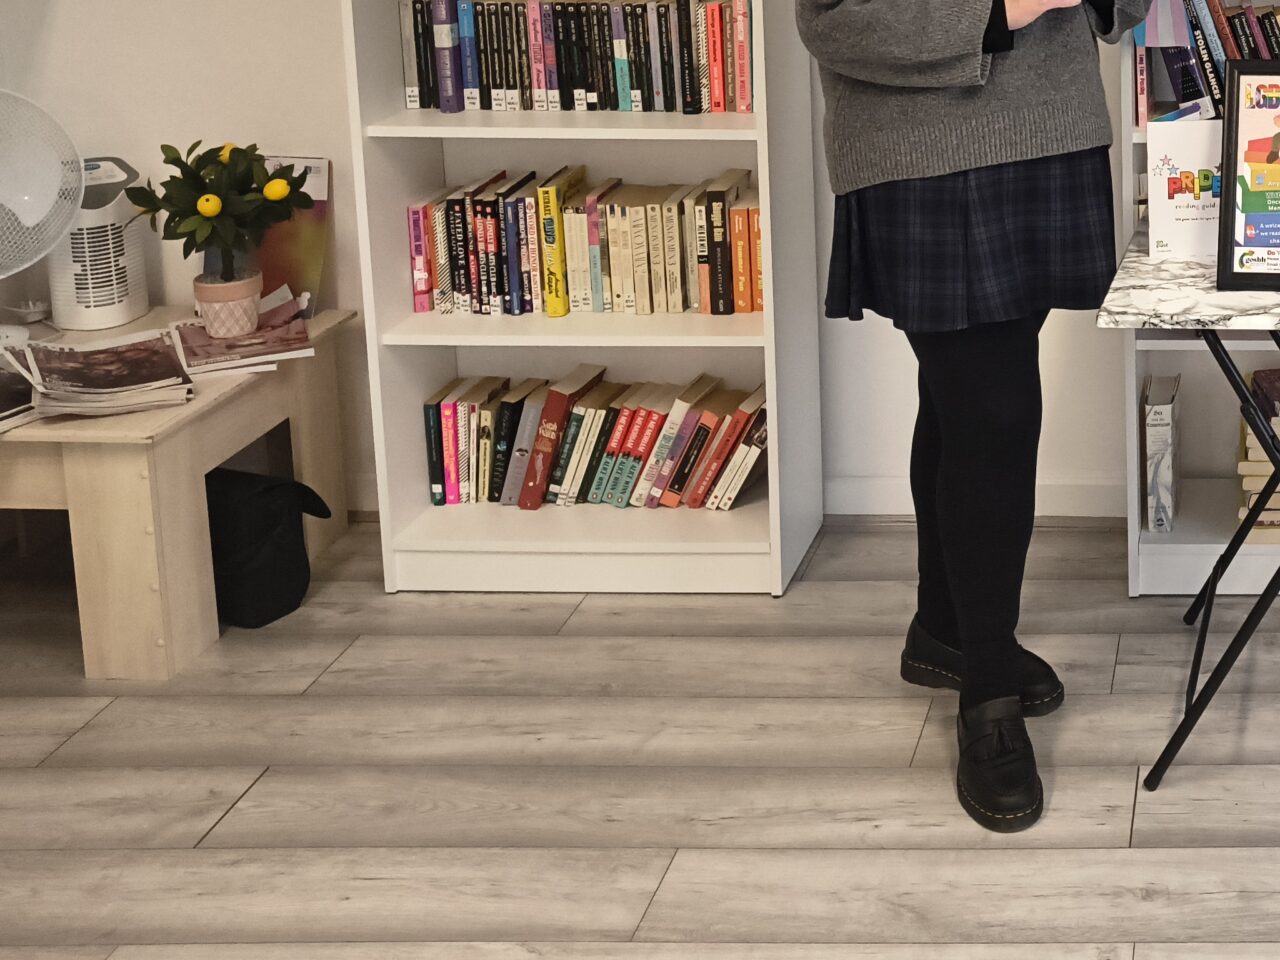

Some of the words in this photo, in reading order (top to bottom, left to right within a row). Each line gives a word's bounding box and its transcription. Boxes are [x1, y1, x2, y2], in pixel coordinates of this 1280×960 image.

[1194, 29, 1207, 63] STOLEN
[1204, 62, 1221, 100] GLANCES
[1168, 169, 1221, 200] PRIDE
[455, 213, 463, 244] FATED
[527, 213, 535, 233] WORD
[457, 244, 466, 266] LOVE
[529, 245, 538, 271] HONOR
[736, 241, 744, 272] Summer
[1245, 256, 1266, 264] goshh
